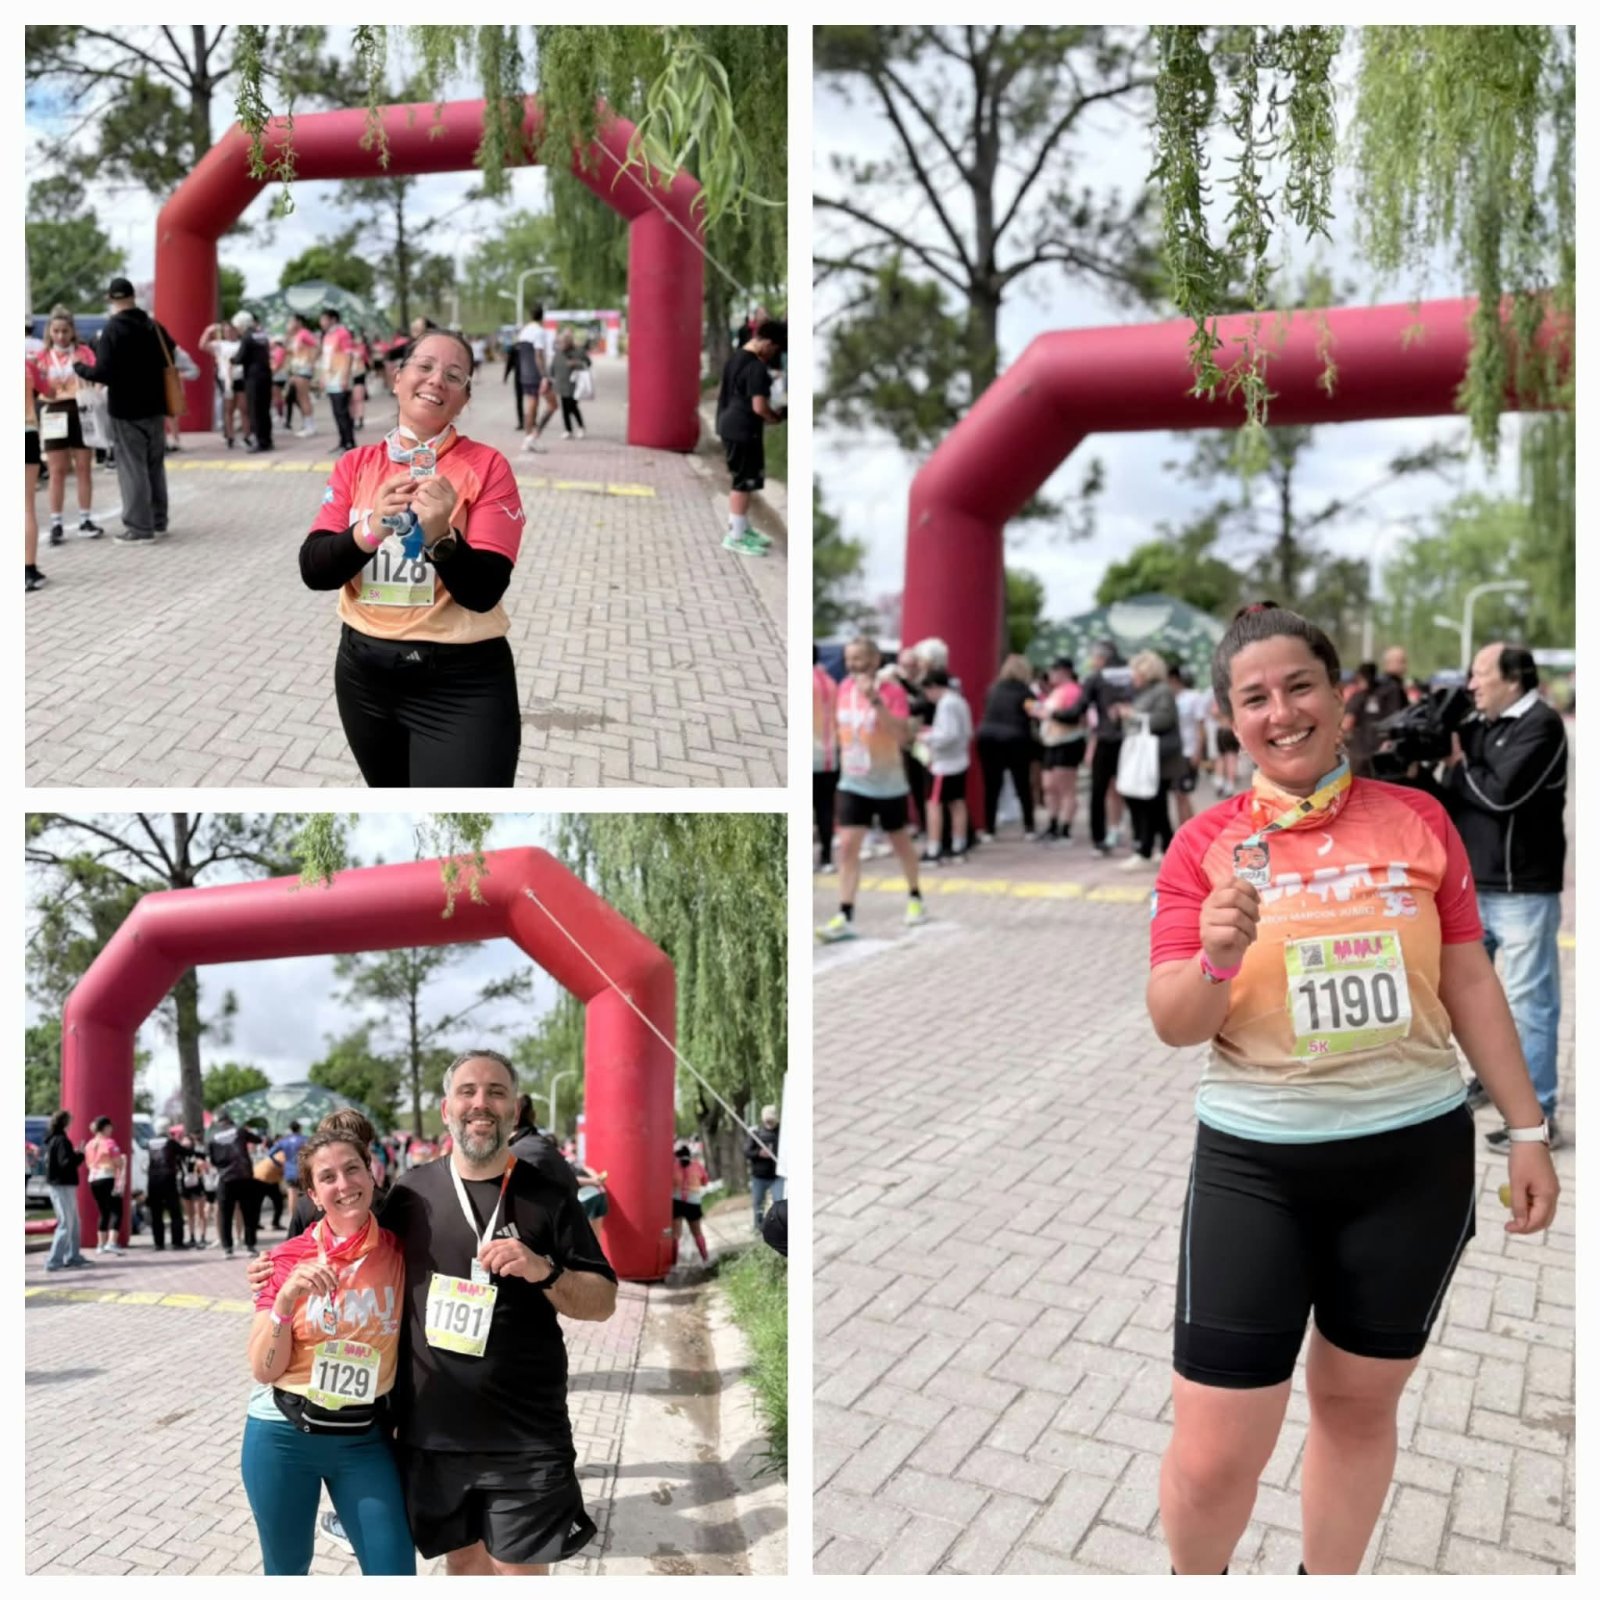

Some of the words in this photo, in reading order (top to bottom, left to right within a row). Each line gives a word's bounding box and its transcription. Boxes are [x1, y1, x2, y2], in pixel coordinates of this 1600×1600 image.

[373, 549, 427, 583] 1128
[1299, 972, 1398, 1030] 1190
[1309, 1040, 1328, 1053] 5K
[434, 1299, 483, 1337] 1191
[319, 1361, 369, 1398] 1129
